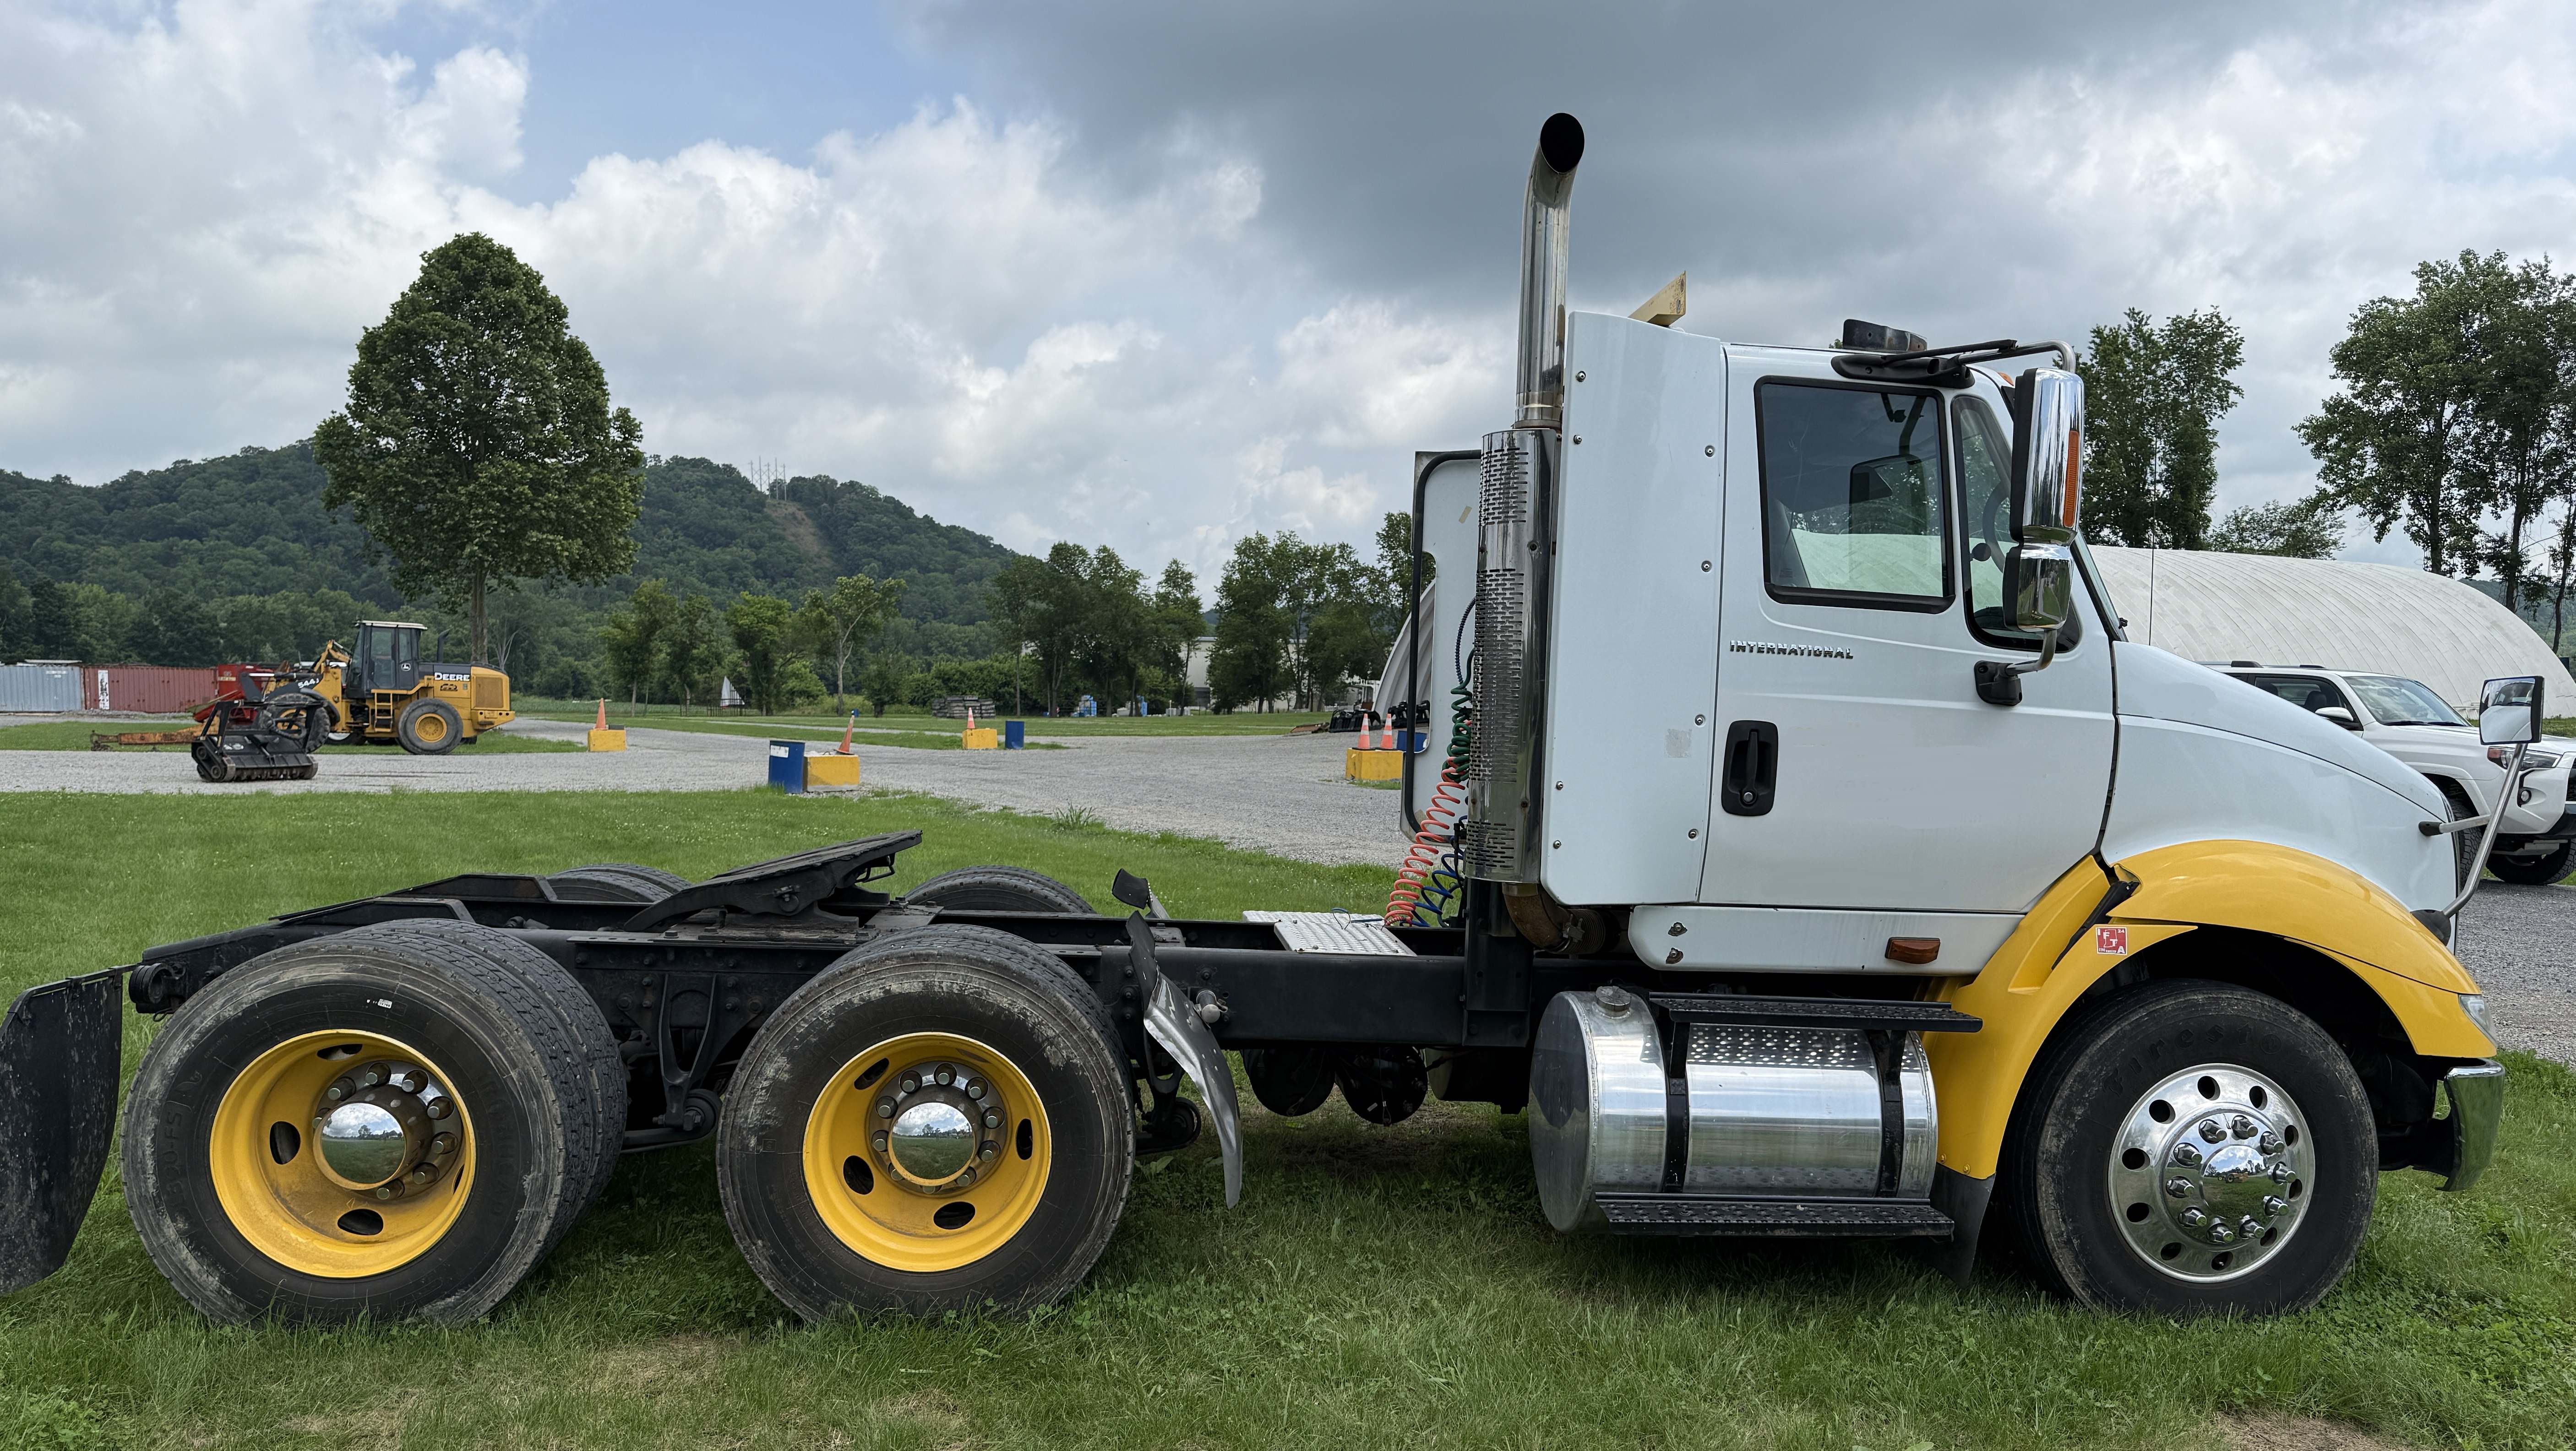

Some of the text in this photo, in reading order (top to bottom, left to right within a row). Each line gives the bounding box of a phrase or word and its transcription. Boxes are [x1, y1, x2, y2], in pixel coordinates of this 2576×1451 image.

[1729, 640, 1854, 659] INTERNATIONAL
[434, 672, 470, 681] DEERE
[2102, 1023, 2329, 1098] Firestone
